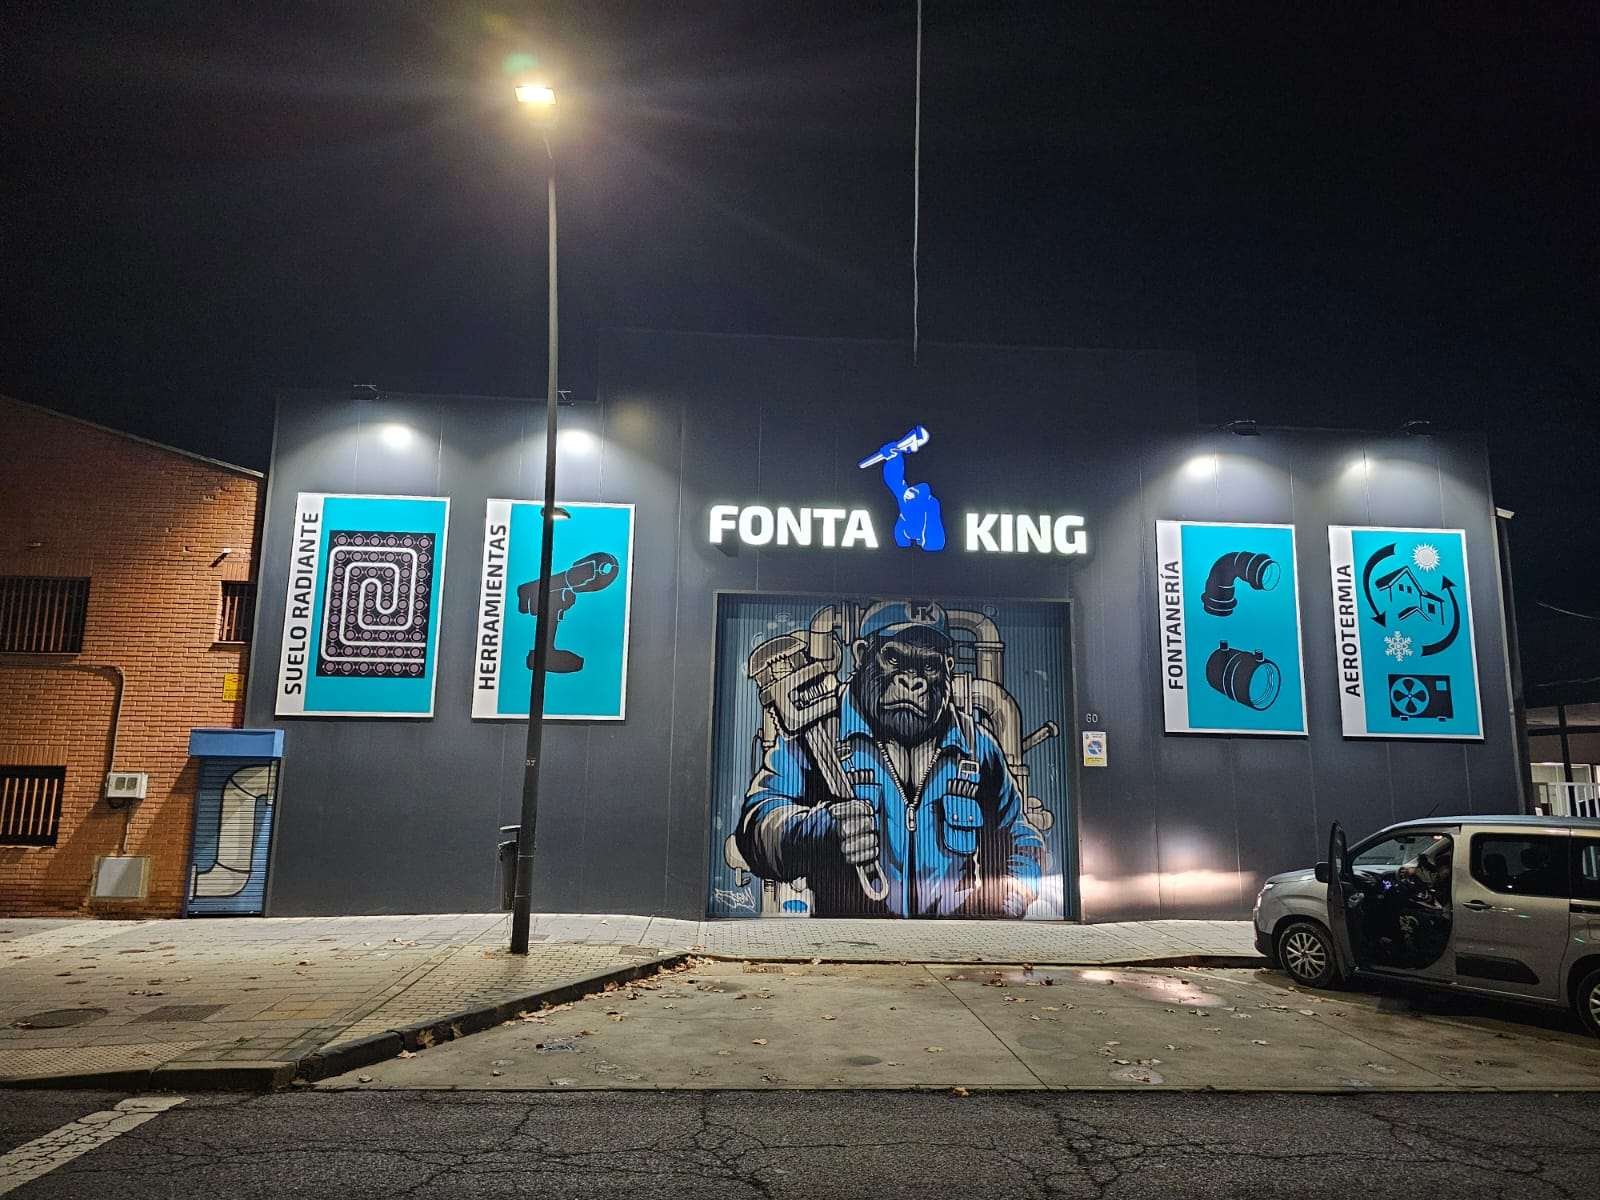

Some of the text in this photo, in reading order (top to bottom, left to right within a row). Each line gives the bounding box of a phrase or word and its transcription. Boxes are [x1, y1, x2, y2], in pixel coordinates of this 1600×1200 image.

[709, 505, 1088, 555] FONTA KING
[284, 512, 319, 695] SUELO RADIANTE
[478, 524, 507, 690] HERRAMIENTAS
[1160, 560, 1183, 690] FONTANERÍA
[1337, 564, 1361, 697] AEROTERMIA
[1086, 713, 1098, 723] 60
